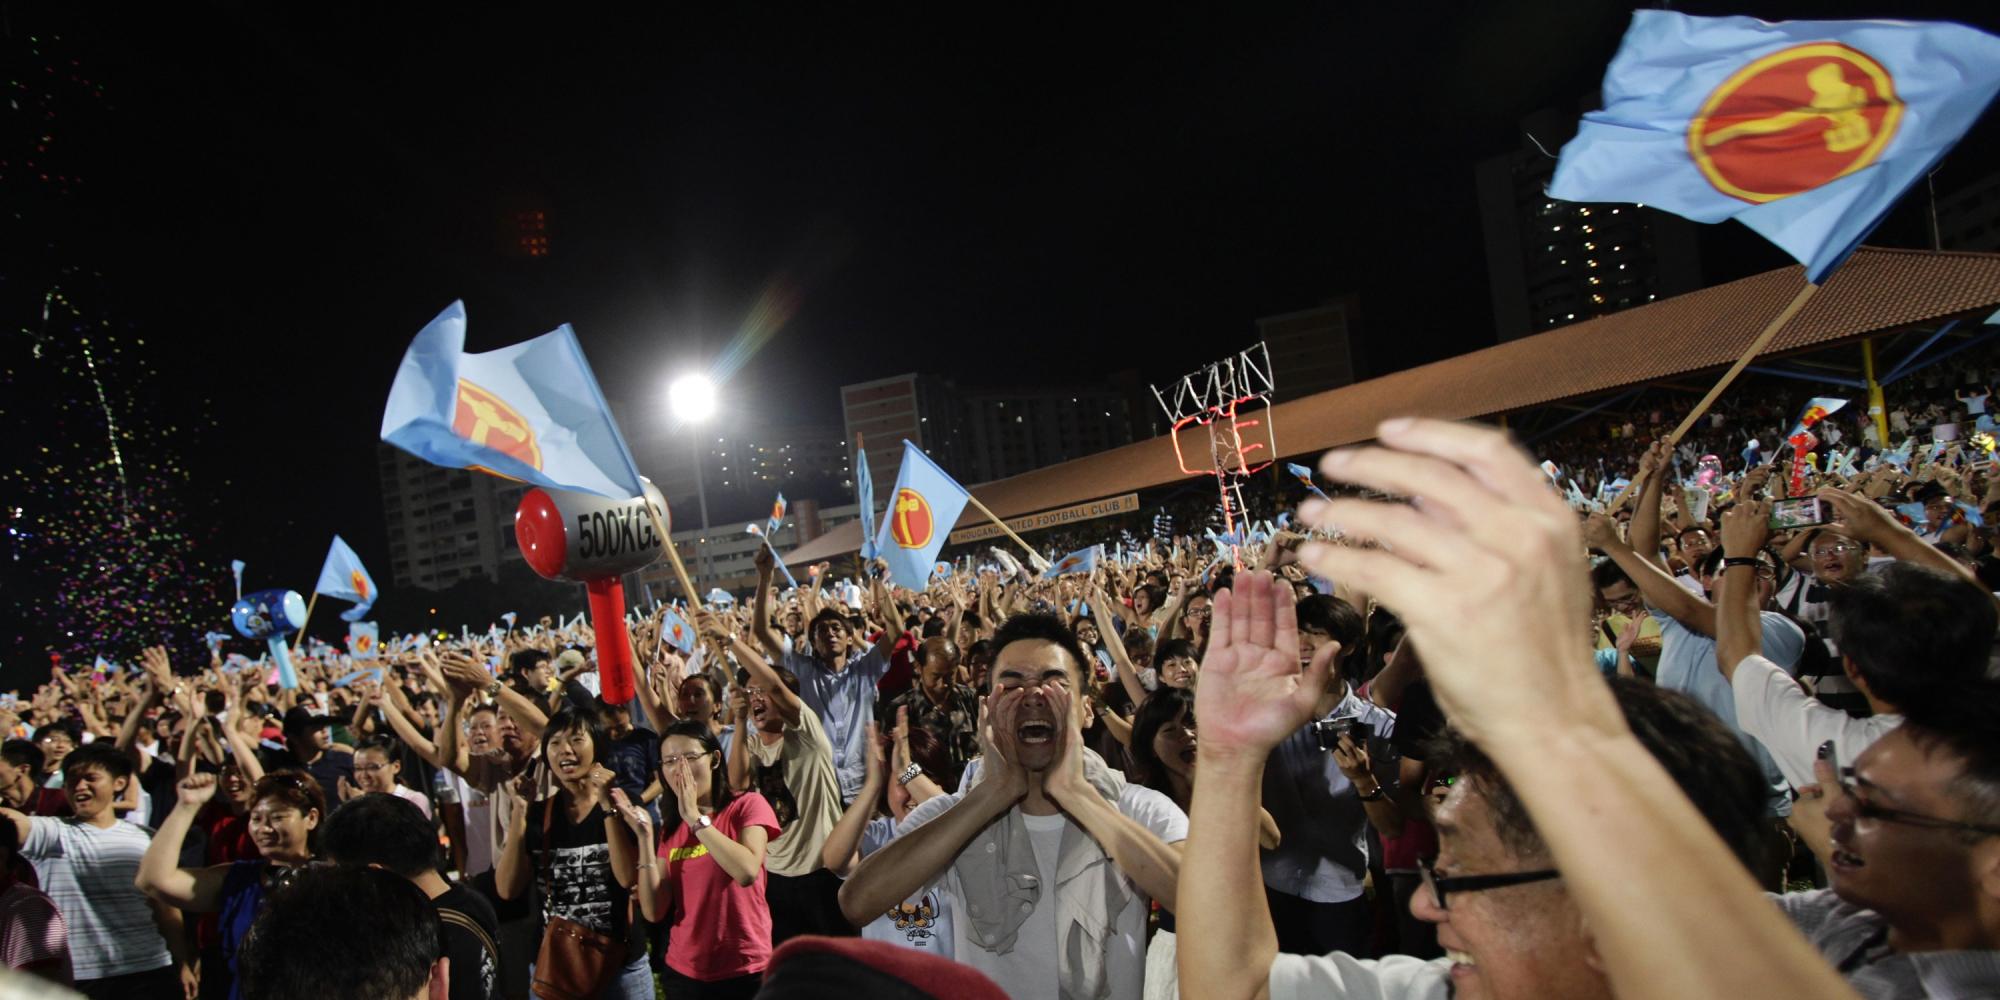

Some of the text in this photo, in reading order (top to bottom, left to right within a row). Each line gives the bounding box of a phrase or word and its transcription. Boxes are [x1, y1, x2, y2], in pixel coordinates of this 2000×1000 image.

[1006, 518, 1034, 531] NITED
[1037, 507, 1087, 525] FOOTBALL
[1091, 500, 1121, 515] CLUB
